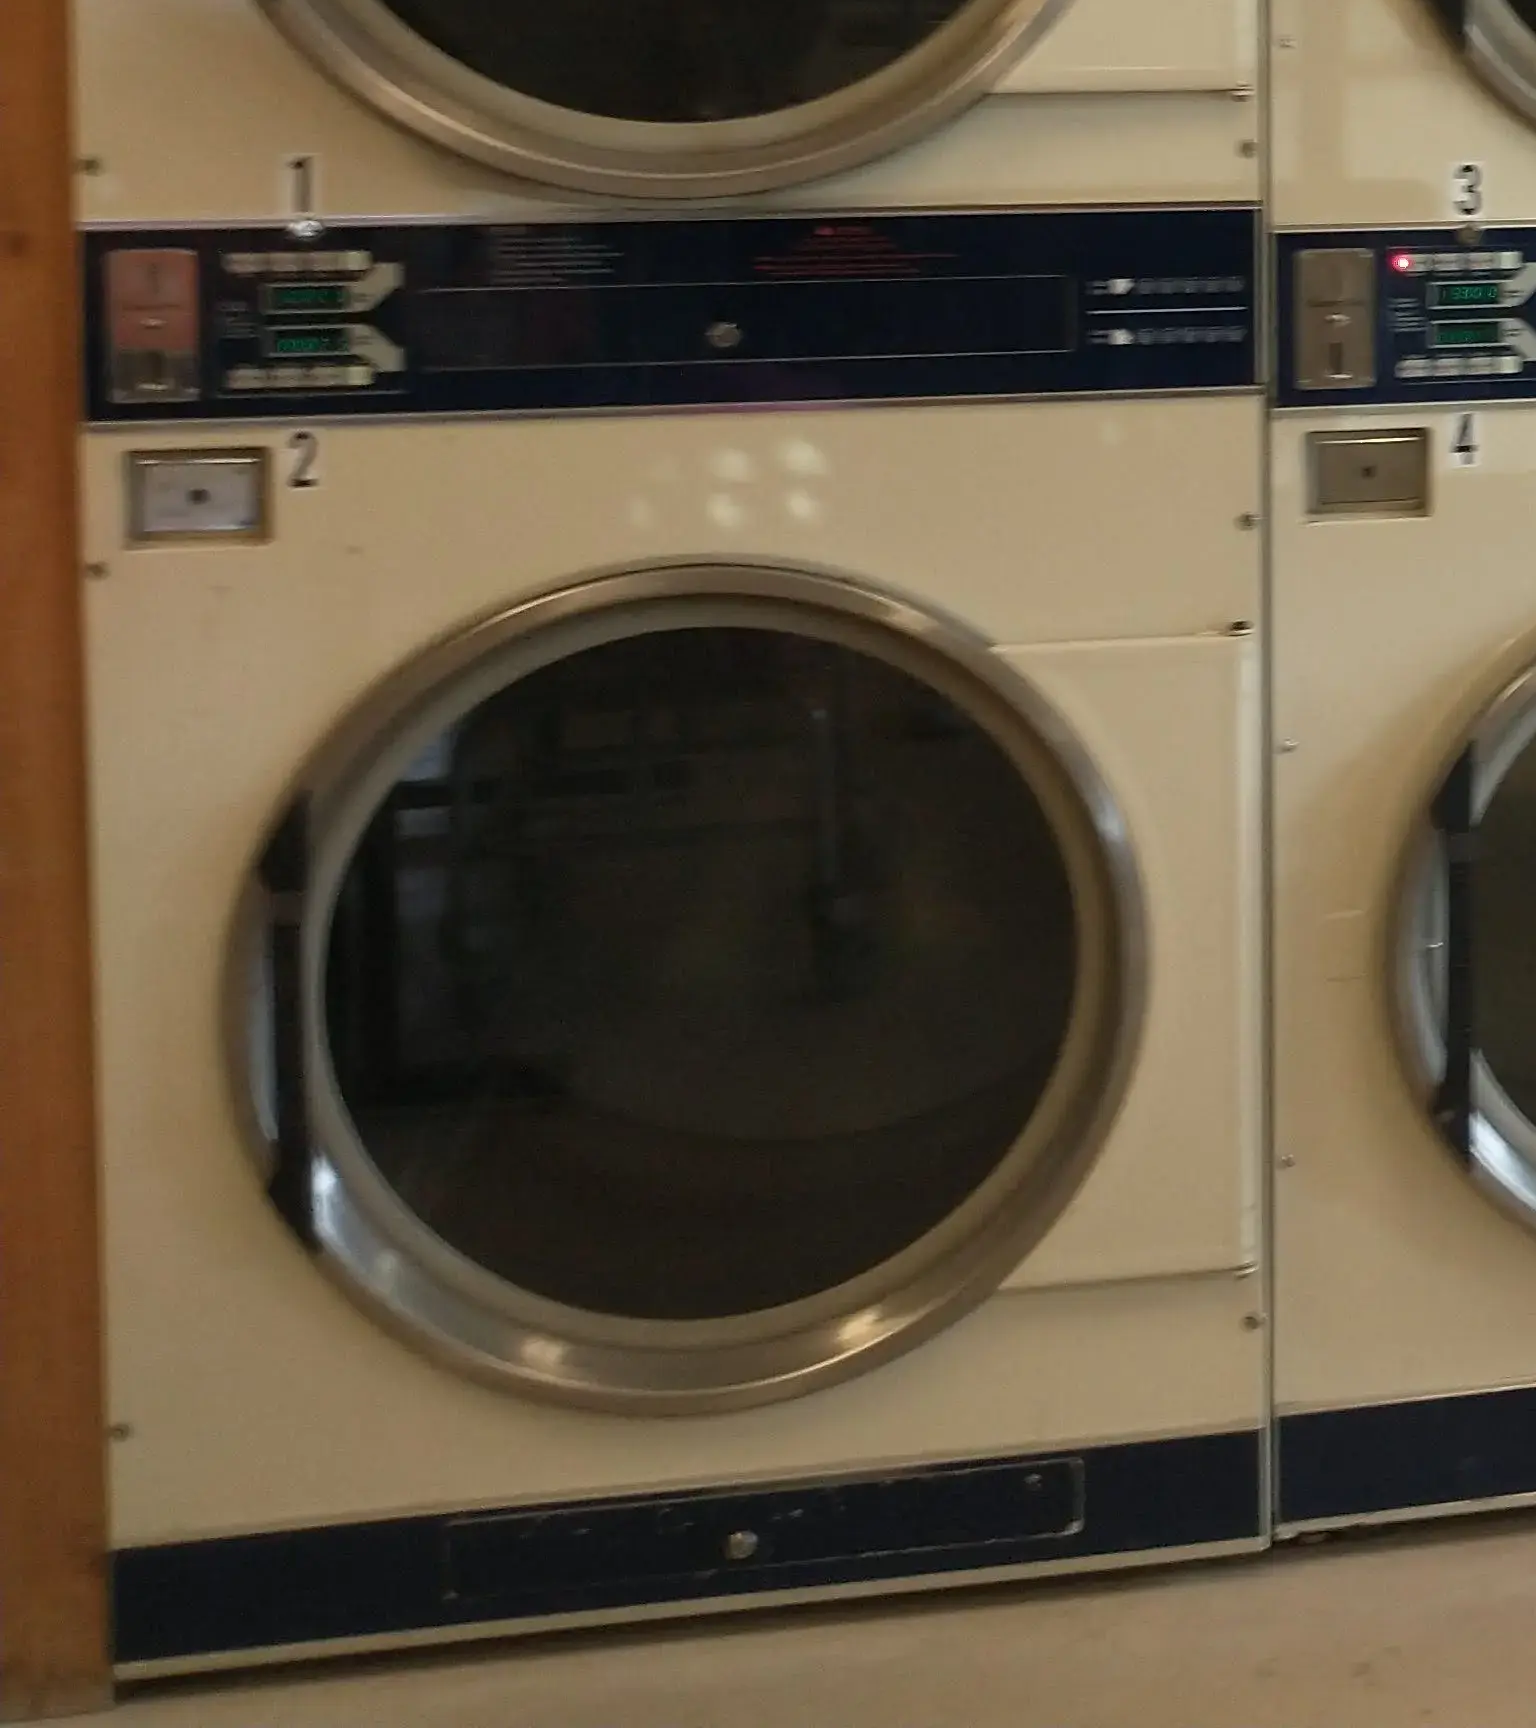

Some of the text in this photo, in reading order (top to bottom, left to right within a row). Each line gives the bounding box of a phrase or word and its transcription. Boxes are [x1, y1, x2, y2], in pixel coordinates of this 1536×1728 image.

[288, 158, 314, 217] 1
[1453, 164, 1483, 215] 3
[287, 431, 318, 487] 2
[1450, 414, 1478, 465] 4
